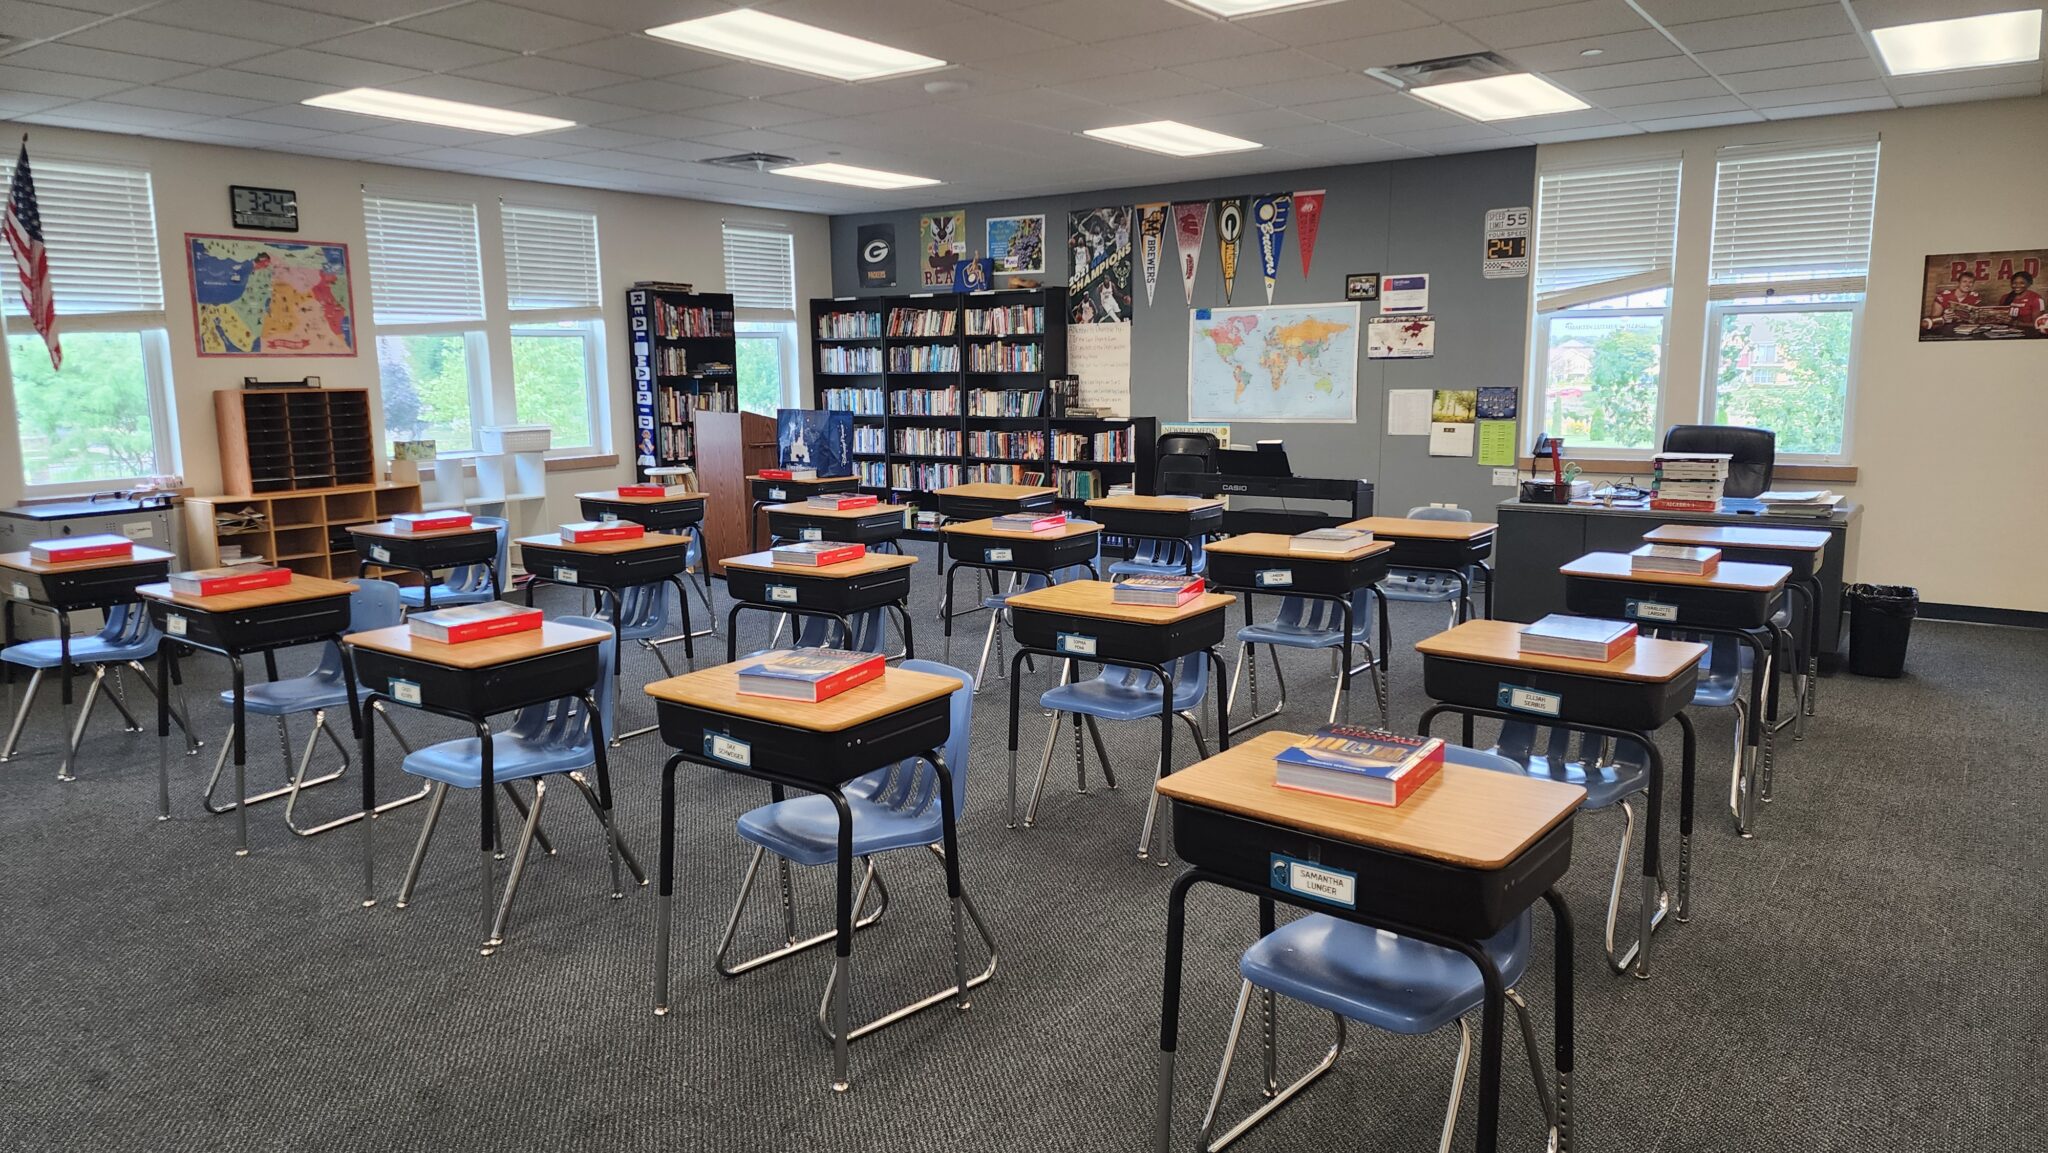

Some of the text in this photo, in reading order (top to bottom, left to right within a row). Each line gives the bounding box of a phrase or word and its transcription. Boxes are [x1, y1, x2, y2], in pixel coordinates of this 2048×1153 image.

[248, 191, 284, 212] 3:24
[1488, 212, 1505, 221] SPEED
[1489, 221, 1504, 229] LIMIT
[1507, 213, 1527, 226] 55
[864, 241, 889, 263] G
[1261, 222, 1275, 275] Brewers
[1069, 242, 1132, 297] CHAMPIONS
[1146, 240, 1156, 284] BREWERS
[1225, 244, 1235, 279] PACKERS
[924, 270, 954, 285] REA
[1069, 263, 1090, 287] 2021
[632, 293, 652, 429] REAL MADRID
[1222, 484, 1248, 492] CASIO
[1643, 605, 1672, 613] CHARLOTTE
[1525, 693, 1546, 703] ELIJAH
[1300, 869, 1344, 888] SAMANTHA
[1306, 880, 1337, 896] LUNGER
